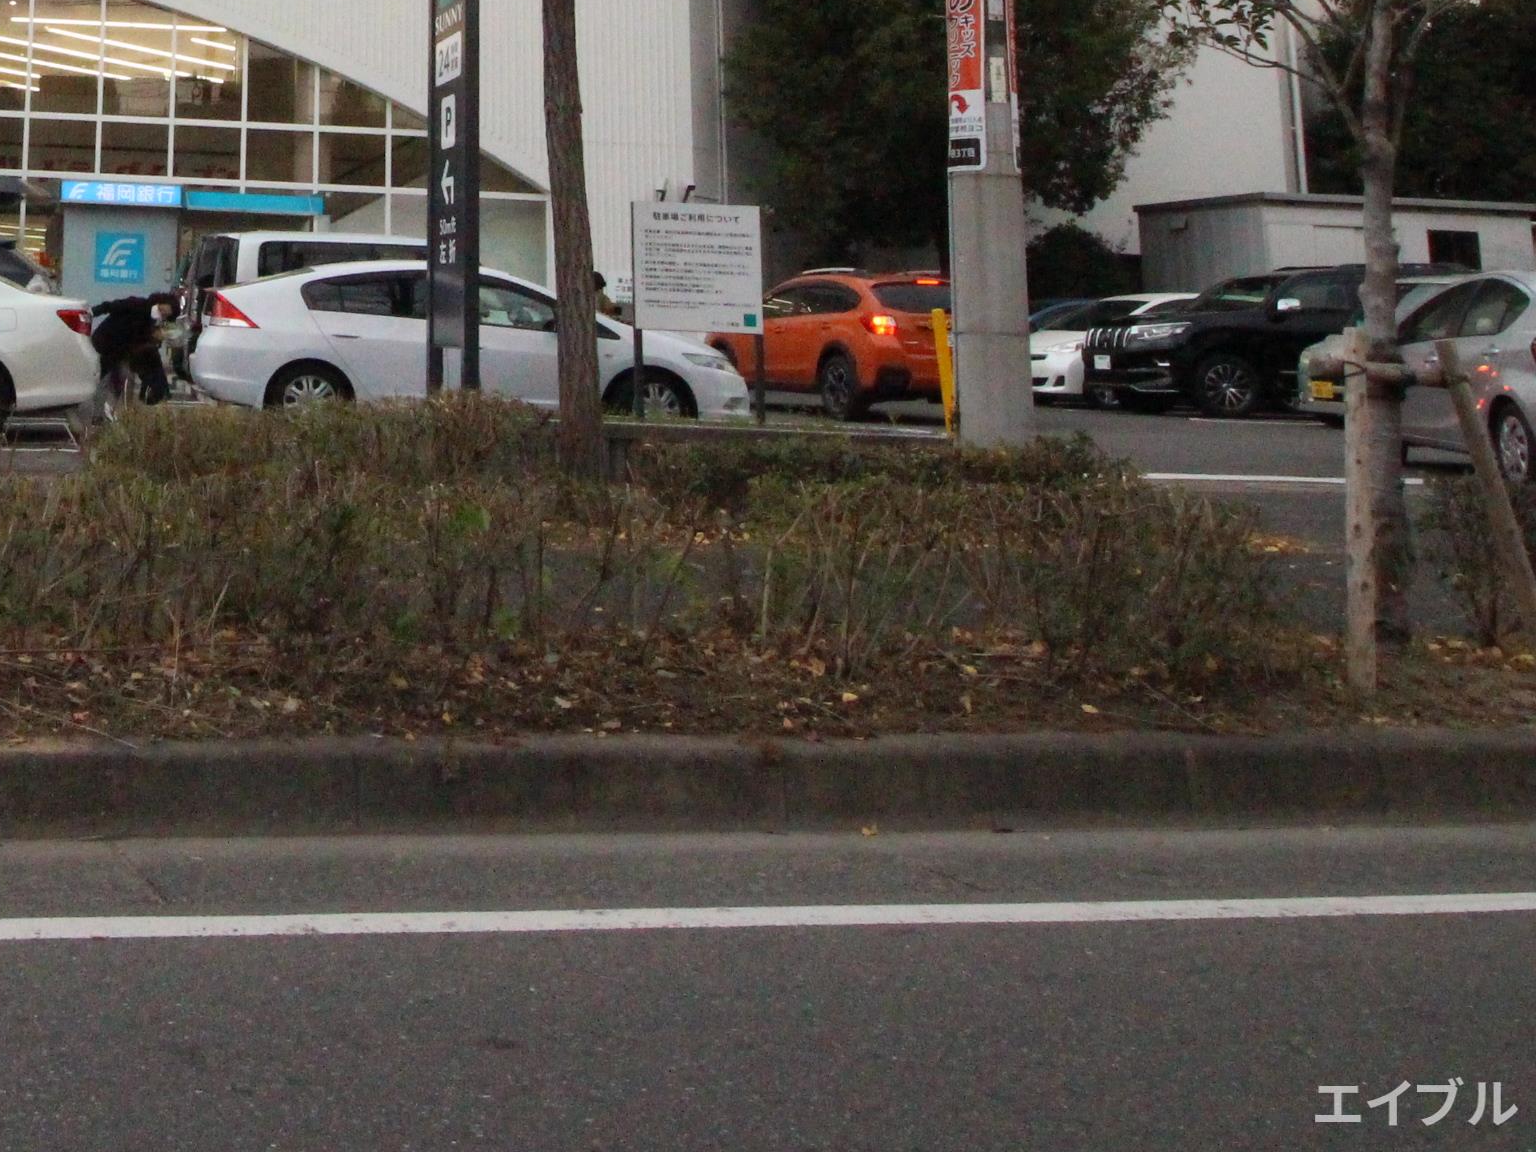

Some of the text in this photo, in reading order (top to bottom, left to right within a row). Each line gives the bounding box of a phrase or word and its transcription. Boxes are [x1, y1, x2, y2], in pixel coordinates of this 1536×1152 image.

[435, 3, 464, 35] SUNNY
[959, 13, 976, 58] キッズ
[445, 106, 452, 138] P
[96, 185, 175, 203] 福岡銀行
